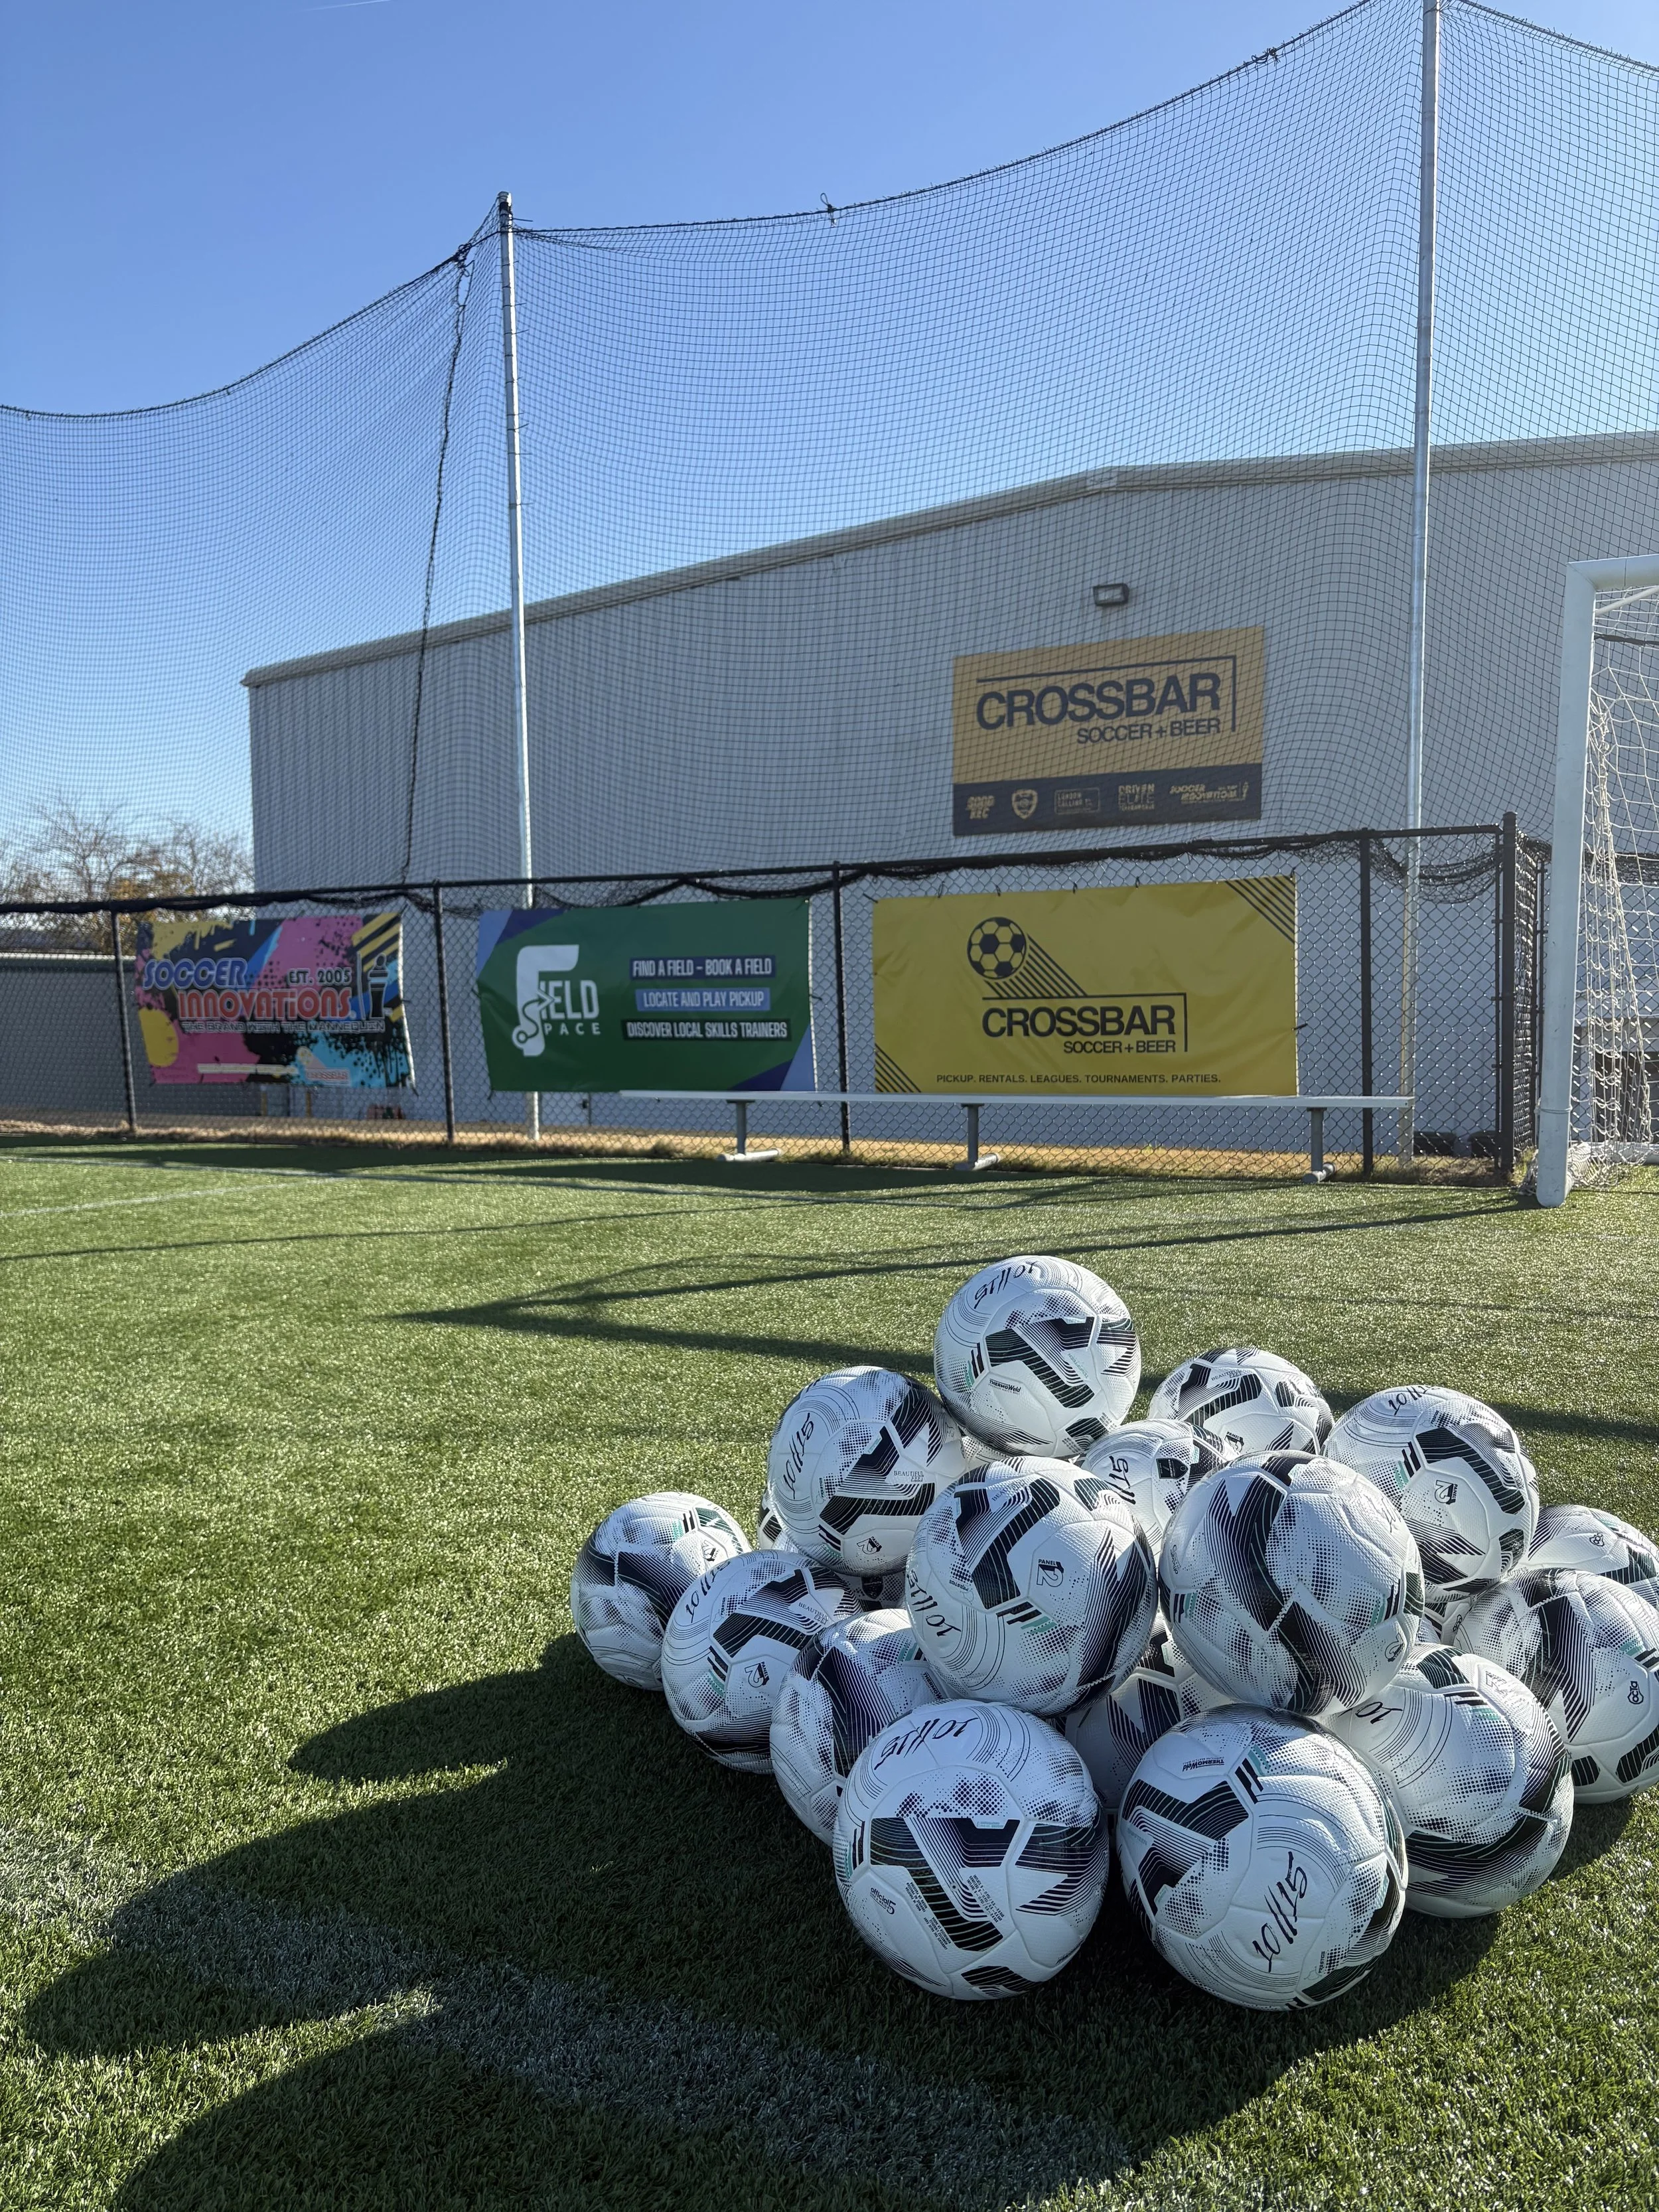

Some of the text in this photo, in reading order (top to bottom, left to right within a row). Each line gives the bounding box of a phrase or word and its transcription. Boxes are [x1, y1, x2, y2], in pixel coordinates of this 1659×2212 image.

[977, 672, 1221, 730] CROSSBAR
[1077, 724, 1152, 743] SOCCER
[1169, 718, 1220, 737] BEER
[143, 958, 248, 990] SOCCER
[632, 960, 656, 976] FIND
[658, 960, 666, 976] A
[667, 960, 694, 976] FIELD
[705, 959, 733, 976] BOOK
[735, 958, 743, 975] A
[745, 958, 772, 975] FIELD
[288, 968, 352, 986] EST. 2005
[643, 991, 764, 1007] LOCATE AND PLAY PICKUP
[181, 1020, 386, 1033] THE BRAND WITH THE MANNEQUIN
[626, 1021, 788, 1038] DISCOVER LOCAL SKILLS TRAINERS
[982, 1004, 1176, 1038] CROSSBAR
[1064, 1040, 1177, 1054] SOCCER + BEER
[936, 1073, 1221, 1083] PICKUP. RENTALS. LEAGUES. TOURNAMENTS. PARTIES.
[1037, 1561, 1064, 1587] 12
